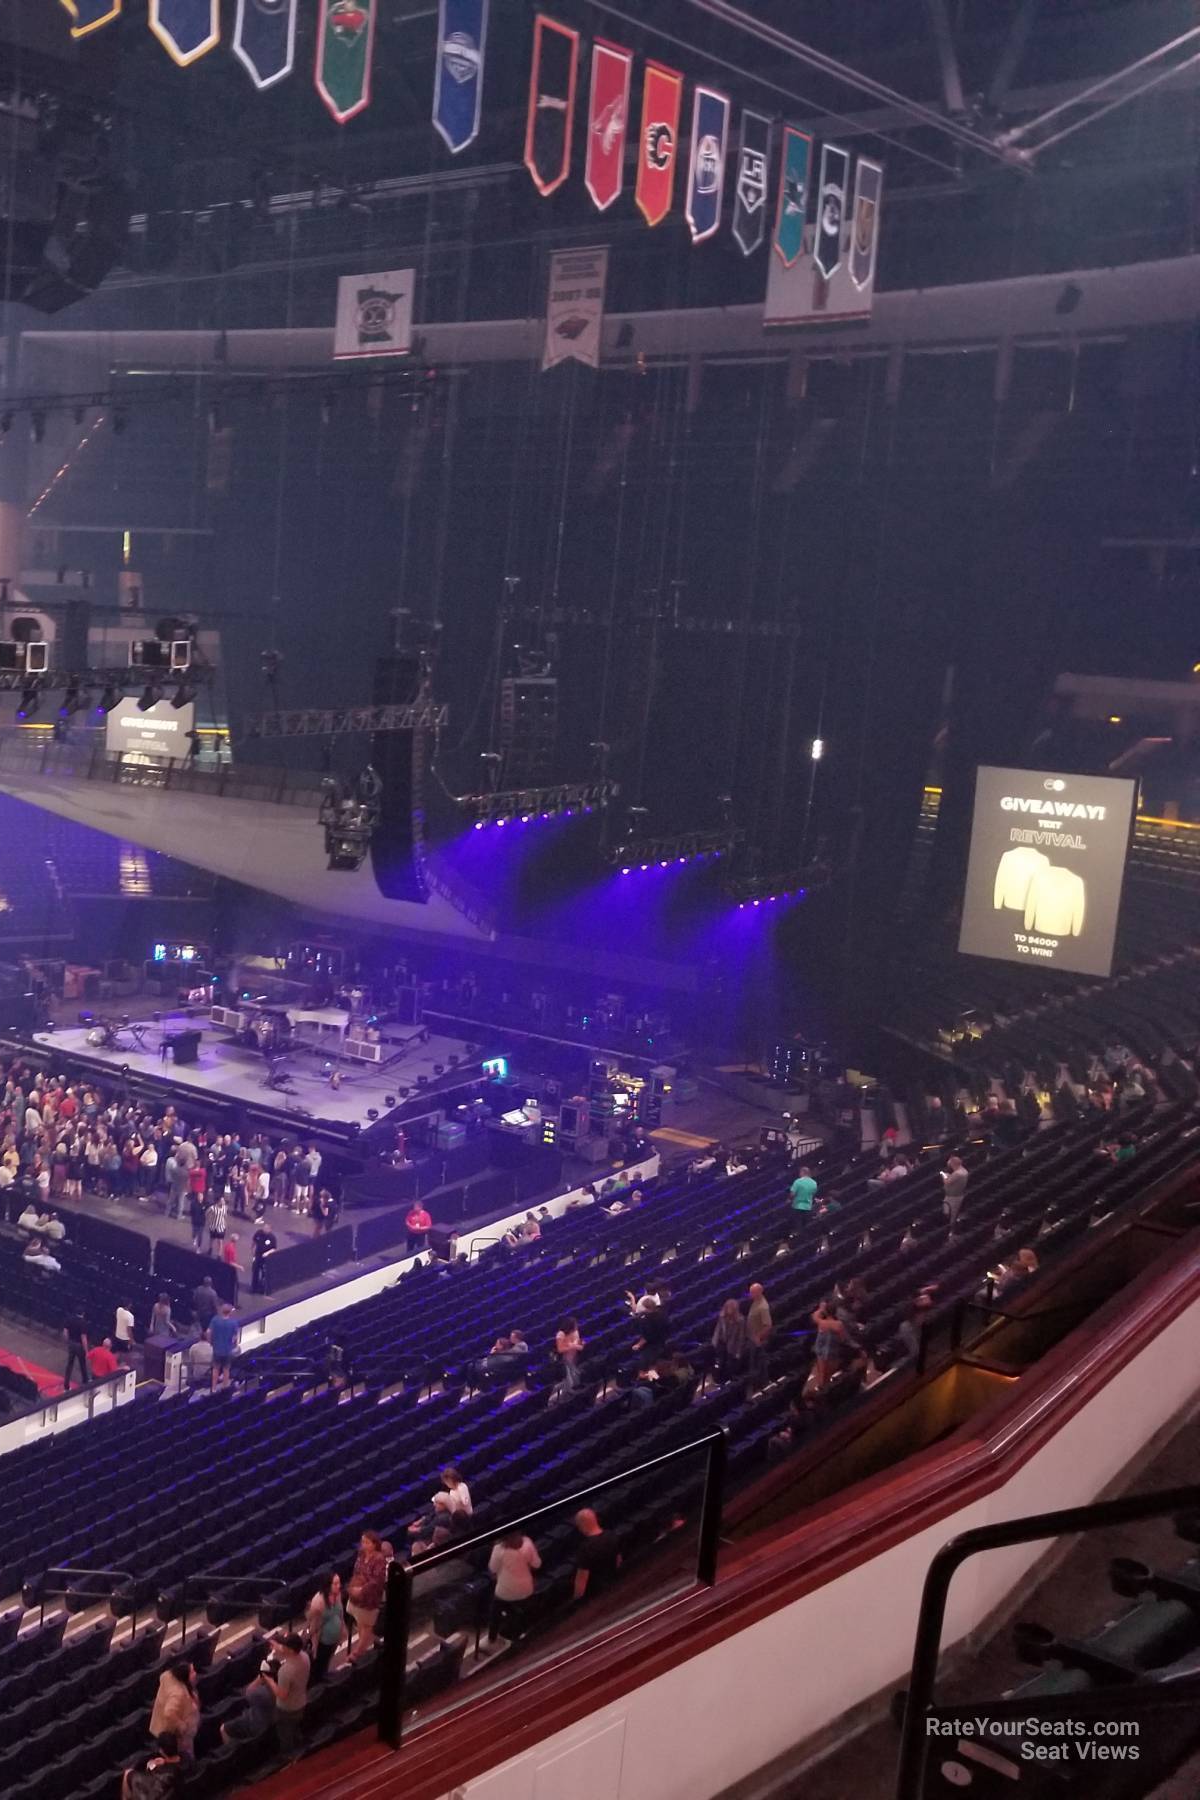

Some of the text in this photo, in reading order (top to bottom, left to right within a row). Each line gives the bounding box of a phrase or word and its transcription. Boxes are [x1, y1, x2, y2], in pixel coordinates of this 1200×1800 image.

[1000, 796, 1106, 820] GIVEAWAY!
[1010, 827, 1087, 850] REVIVAL
[1014, 933, 1027, 942] TO
[1017, 944, 1030, 953] TO
